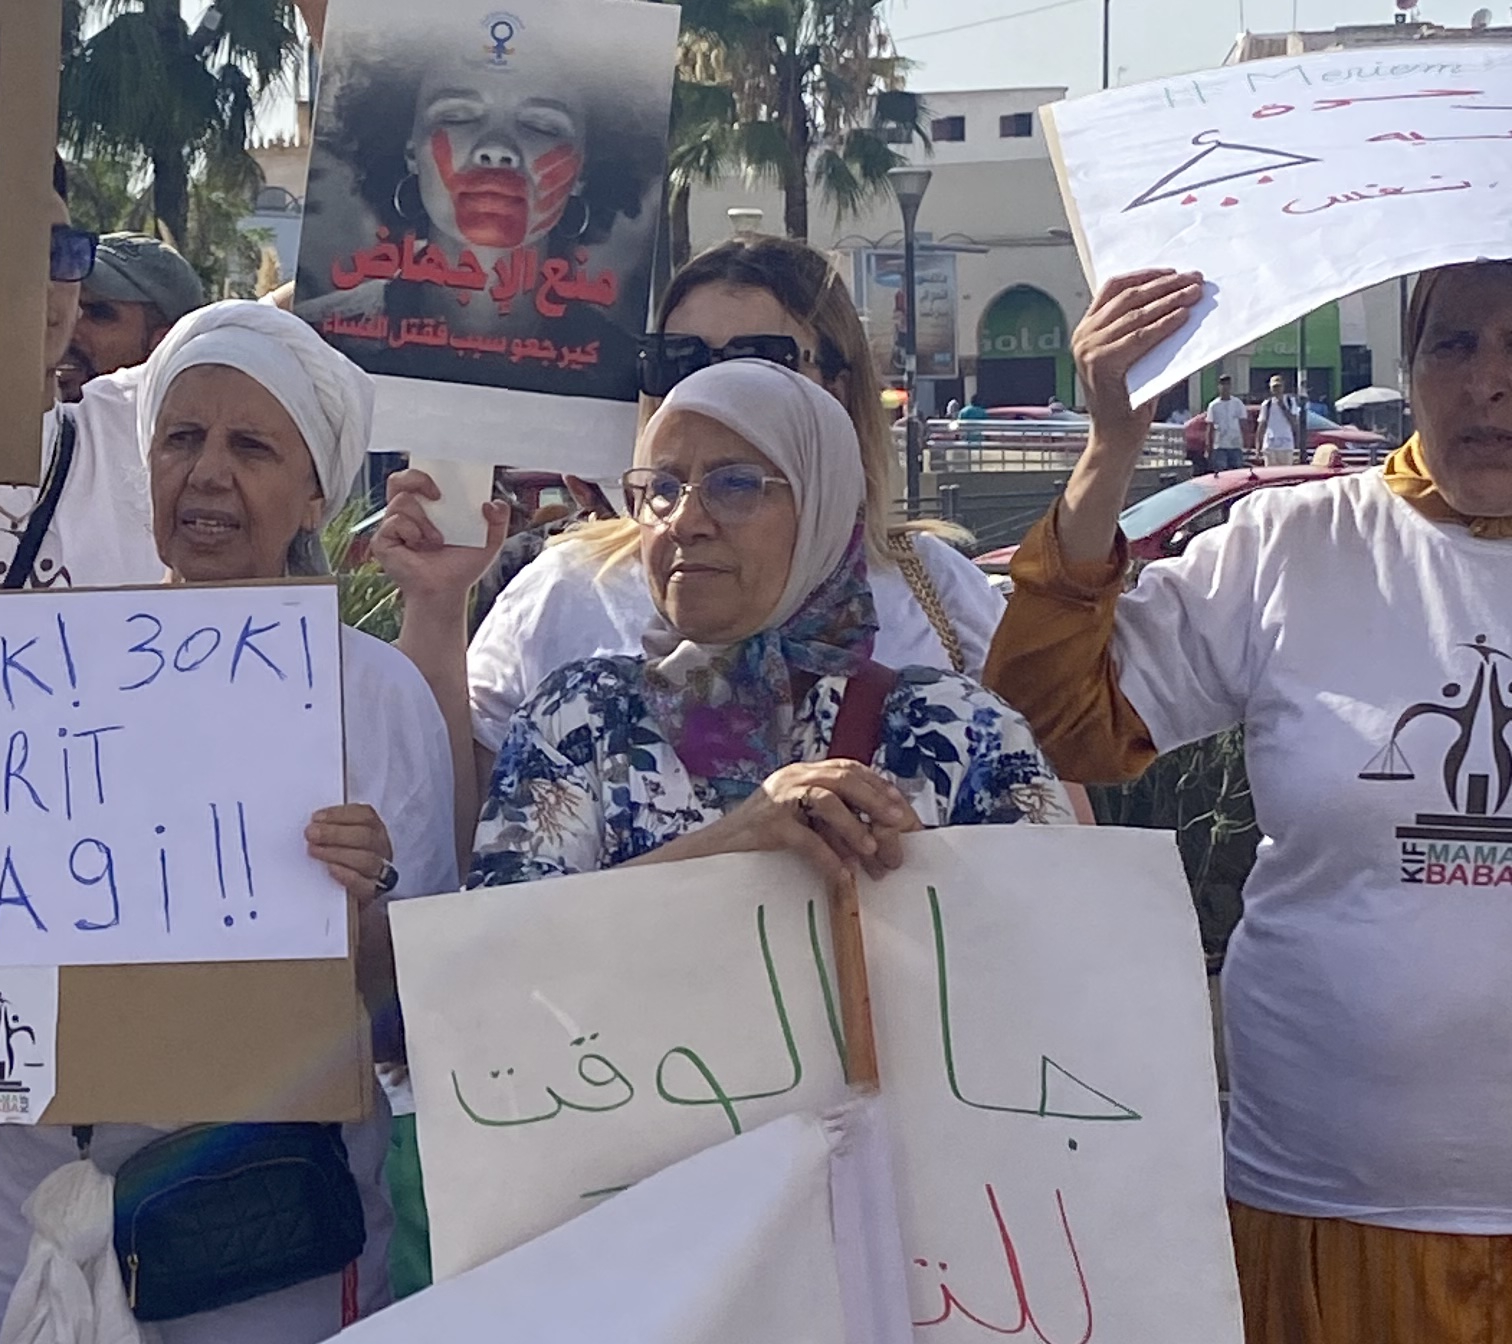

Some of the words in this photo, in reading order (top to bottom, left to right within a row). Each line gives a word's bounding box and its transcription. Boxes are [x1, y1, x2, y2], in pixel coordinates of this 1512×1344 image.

[331, 226, 538, 315] الإجهاض
[535, 246, 618, 318] منع
[1400, 841, 1426, 883] KIF
[1426, 863, 1512, 887] BABA
[1428, 843, 1512, 864] MAMA
[452, 899, 849, 1135] الوقت
